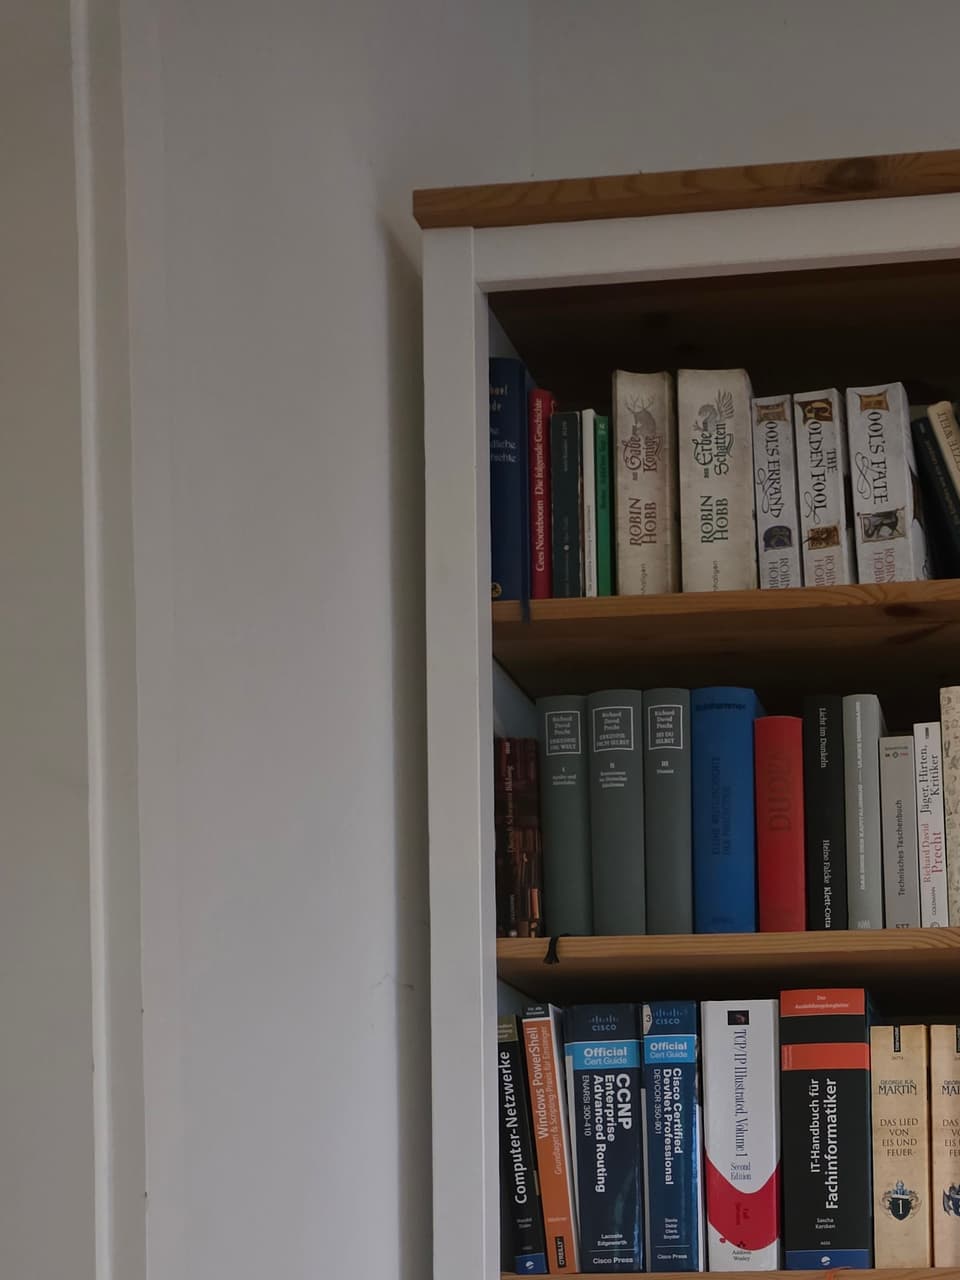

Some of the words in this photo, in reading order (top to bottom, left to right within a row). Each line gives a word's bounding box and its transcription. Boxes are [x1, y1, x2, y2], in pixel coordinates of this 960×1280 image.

[936, 411, 954, 440] WELT
[826, 449, 838, 472] THE
[535, 479, 544, 495] Die
[810, 471, 827, 514] FOOL
[869, 459, 888, 505] FATE
[535, 500, 545, 550] Nooteboom
[628, 498, 642, 547] ROBIN
[642, 502, 657, 544] HOBB
[700, 495, 714, 544] ROBIN
[714, 498, 729, 540] HOBB
[535, 552, 545, 572] Cees
[930, 754, 940, 796] Kritiker
[895, 799, 905, 849] Taschenbuch
[920, 824, 931, 848] David
[896, 851, 906, 896] Technisches
[922, 850, 932, 883] Richard
[930, 832, 944, 874] Precht
[823, 887, 833, 929] Klett-Cotta
[526, 1027, 545, 1085] PowerShell
[584, 1047, 627, 1057] Official
[650, 1042, 688, 1050] Official
[734, 1029, 747, 1063] TCP/IP
[581, 1074, 591, 1103] ENARSI
[616, 1073, 632, 1130] CCNP
[653, 1069, 662, 1102] DEVCOR
[663, 1069, 673, 1112] DevNet
[672, 1068, 682, 1100] Cisco
[811, 1078, 820, 1092] für
[879, 1084, 917, 1096] MARTIN
[499, 1050, 527, 1204] Computer-Netzwerke
[535, 1086, 550, 1139] Windows
[583, 1105, 592, 1136] 300-410
[593, 1074, 606, 1141] Advanced
[603, 1074, 616, 1142] Enterprise
[672, 1103, 683, 1153] Certified
[880, 1118, 897, 1127] DAS
[663, 1114, 674, 1184] Professional
[735, 1118, 749, 1150] Volume
[810, 1093, 821, 1173] IT-Handbuch
[824, 1078, 839, 1209] Fachinformatiker
[889, 1129, 909, 1137] VON
[896, 1138, 918, 1146] UND
[594, 1143, 607, 1192] Routing
[730, 1162, 750, 1171] Second
